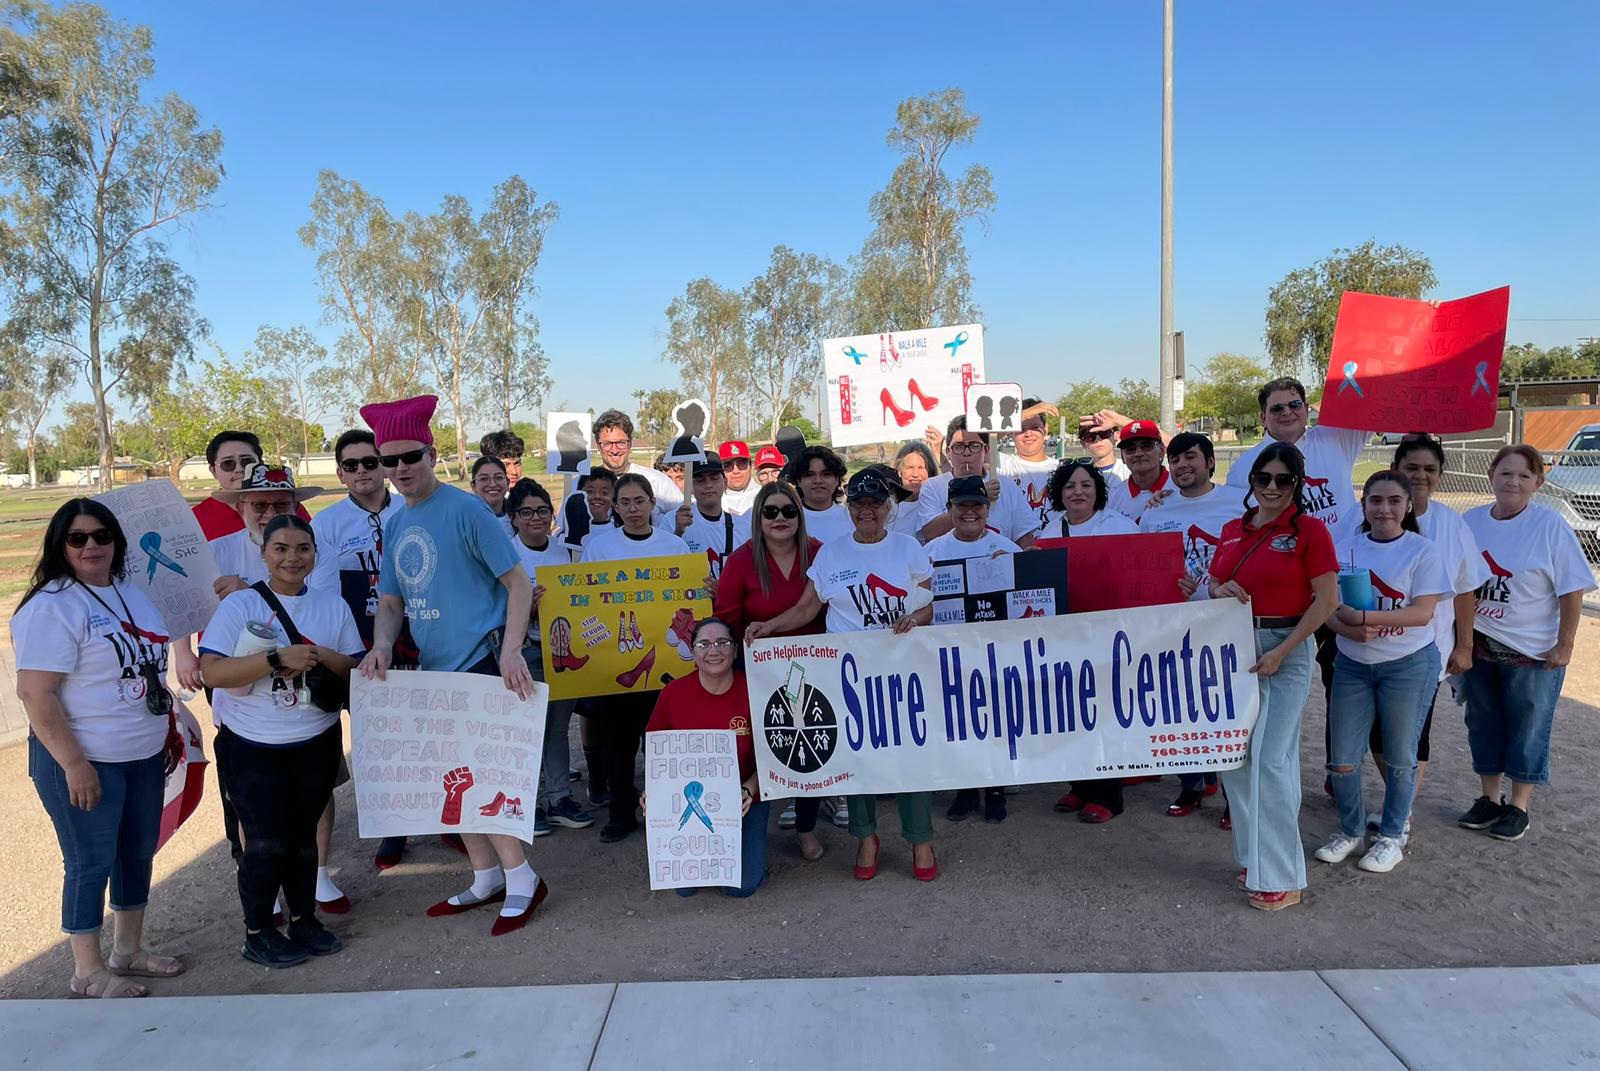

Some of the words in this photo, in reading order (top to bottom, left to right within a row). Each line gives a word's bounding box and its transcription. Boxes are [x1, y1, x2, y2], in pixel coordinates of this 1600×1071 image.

[175, 547, 199, 559] SHC
[558, 572, 610, 587] WALK
[615, 569, 628, 582] A
[635, 567, 680, 580] MILE
[570, 593, 590, 607] IN
[600, 589, 654, 604] THEIR
[662, 587, 711, 601] SHOE
[1012, 591, 1030, 599] WALK
[1031, 590, 1036, 598] A
[1036, 588, 1052, 597] MILE
[582, 615, 597, 627] STOP
[752, 649, 771, 662] Sure
[773, 643, 808, 661] Helpline
[809, 644, 838, 658] Center
[369, 686, 471, 712] SPEAK
[483, 691, 519, 715] UP
[840, 652, 926, 752] Sure
[939, 637, 1096, 761] Helpline
[1112, 627, 1237, 729] Center
[362, 714, 401, 733] FOR
[413, 716, 456, 736] THE
[650, 732, 731, 756] THEIR
[1149, 728, 1249, 744] 760-352-7878
[365, 738, 460, 762] SPEAK
[474, 743, 529, 770] OUT
[358, 765, 447, 784] AGAINST
[475, 768, 532, 791] SEXUA
[650, 756, 734, 780] FIGHT
[787, 777, 799, 789] just
[804, 781, 823, 792] phone
[823, 776, 834, 787] call
[359, 791, 443, 811] ASSAULT
[669, 834, 726, 857] OUR
[655, 859, 737, 882] FIGHT
